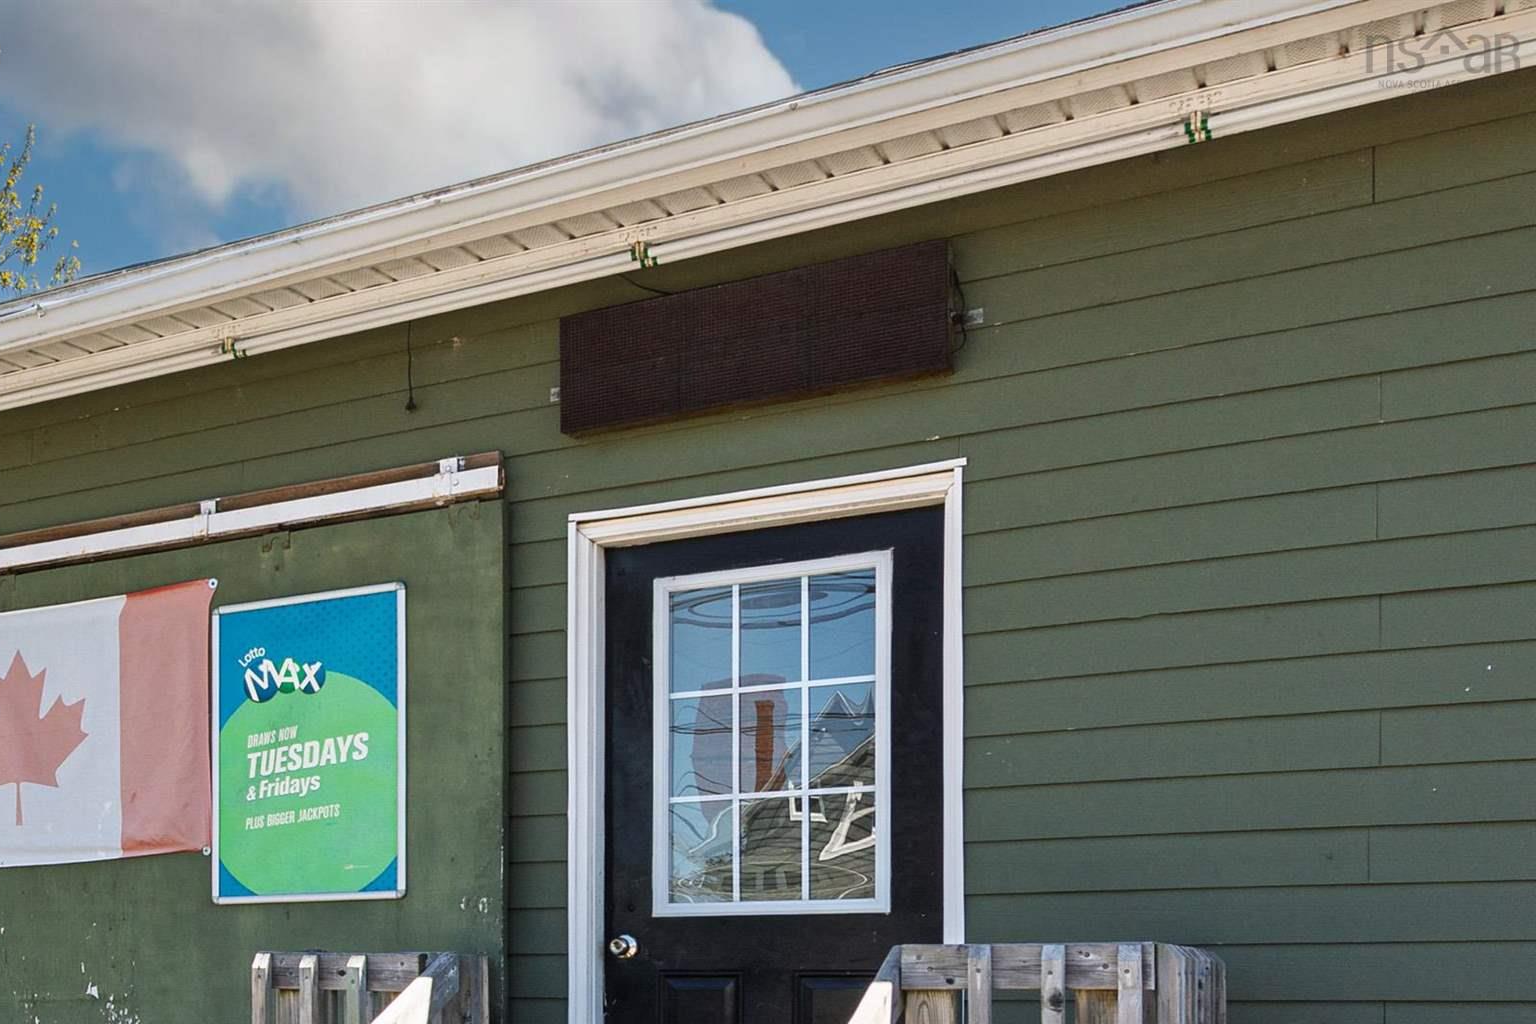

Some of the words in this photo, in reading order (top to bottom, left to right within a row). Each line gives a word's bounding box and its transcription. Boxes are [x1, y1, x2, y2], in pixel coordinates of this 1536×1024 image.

[238, 647, 266, 667] Lotto
[244, 658, 322, 702] MAX
[247, 730, 276, 748] DRAWS
[278, 725, 298, 742] NOW
[247, 732, 369, 779] TUESDAYS
[246, 785, 257, 801] &
[259, 775, 321, 798] Fridays
[245, 815, 265, 830] PLUS
[267, 810, 295, 827] BIGGER
[297, 803, 341, 823] JACKPOTS
